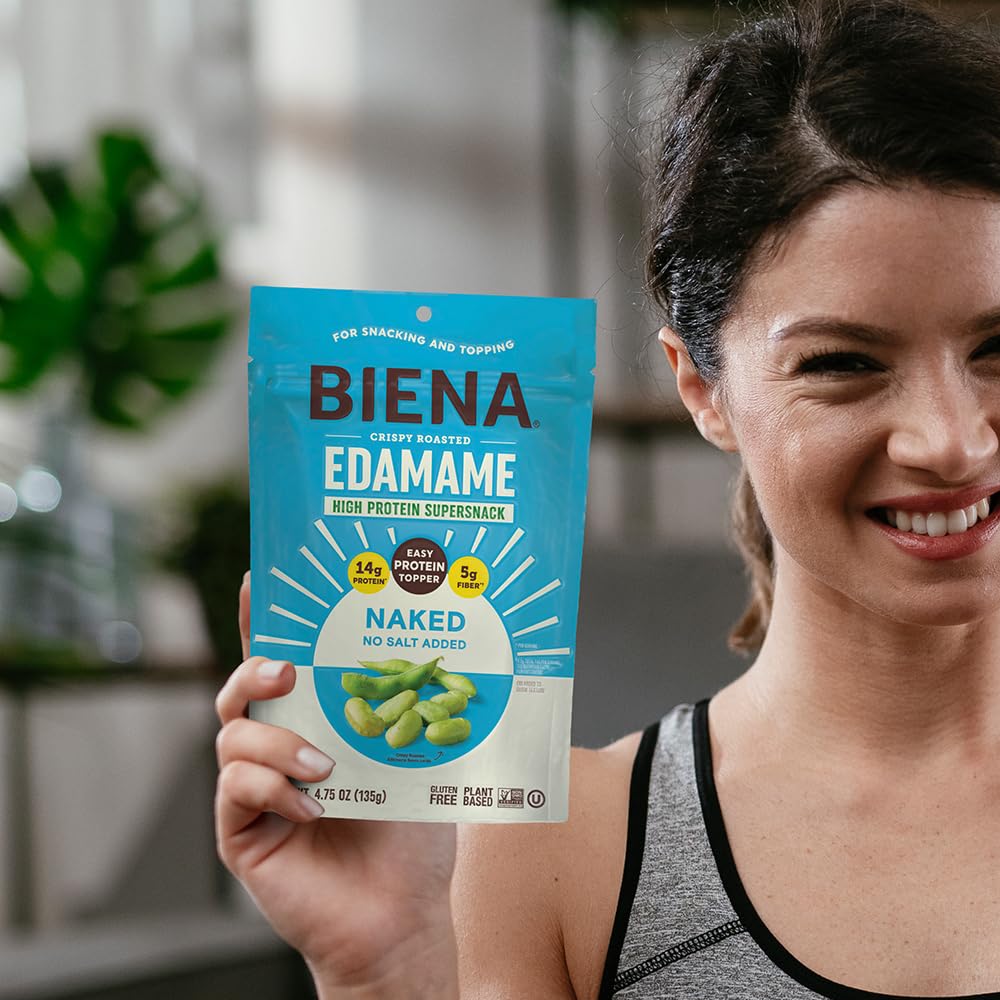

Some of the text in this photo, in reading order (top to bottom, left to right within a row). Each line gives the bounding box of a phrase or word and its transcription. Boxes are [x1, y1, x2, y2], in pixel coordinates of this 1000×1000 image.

[332, 327, 515, 355] FOR SNACKING AND TOPPING
[309, 364, 533, 428] BIENA
[370, 432, 471, 445] CRISPY ROASTED
[324, 446, 516, 497] EDAMAME
[332, 500, 506, 520] HIGH PROTEIN SUPERSNACK
[407, 549, 434, 558] EASY
[356, 561, 382, 577] 14g
[394, 560, 445, 572] PROTEIN
[399, 573, 440, 583] TOPPER
[460, 566, 478, 581] 5g
[365, 607, 466, 632] NAKED
[363, 636, 466, 650] NO SALT ADDED
[314, 788, 335, 800] 4.75
[339, 789, 351, 801] OZ
[354, 788, 387, 805] (135g)
[430, 785, 458, 794] GLUTEN
[464, 787, 493, 797] PLANT
[430, 794, 457, 805] FREE
[463, 796, 493, 807] BASED
